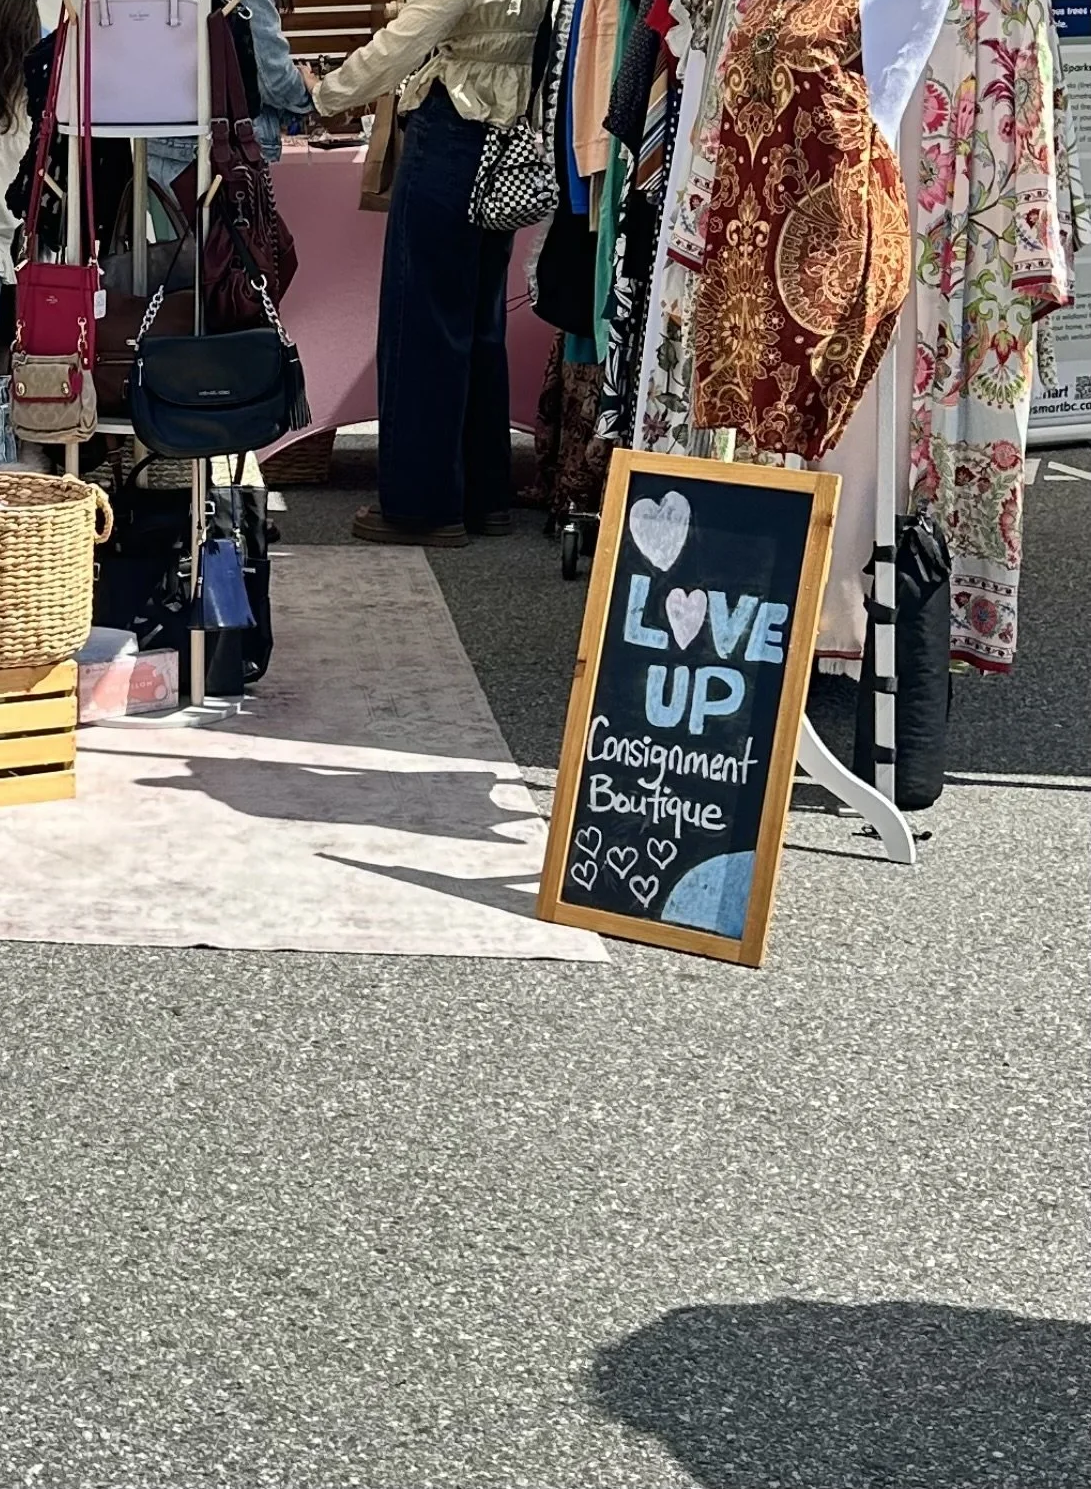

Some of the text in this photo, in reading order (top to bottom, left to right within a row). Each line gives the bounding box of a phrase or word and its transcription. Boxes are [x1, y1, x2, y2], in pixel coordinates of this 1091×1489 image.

[646, 665, 745, 735] UP
[586, 714, 758, 789] Consignment
[588, 774, 728, 838] Boutique
